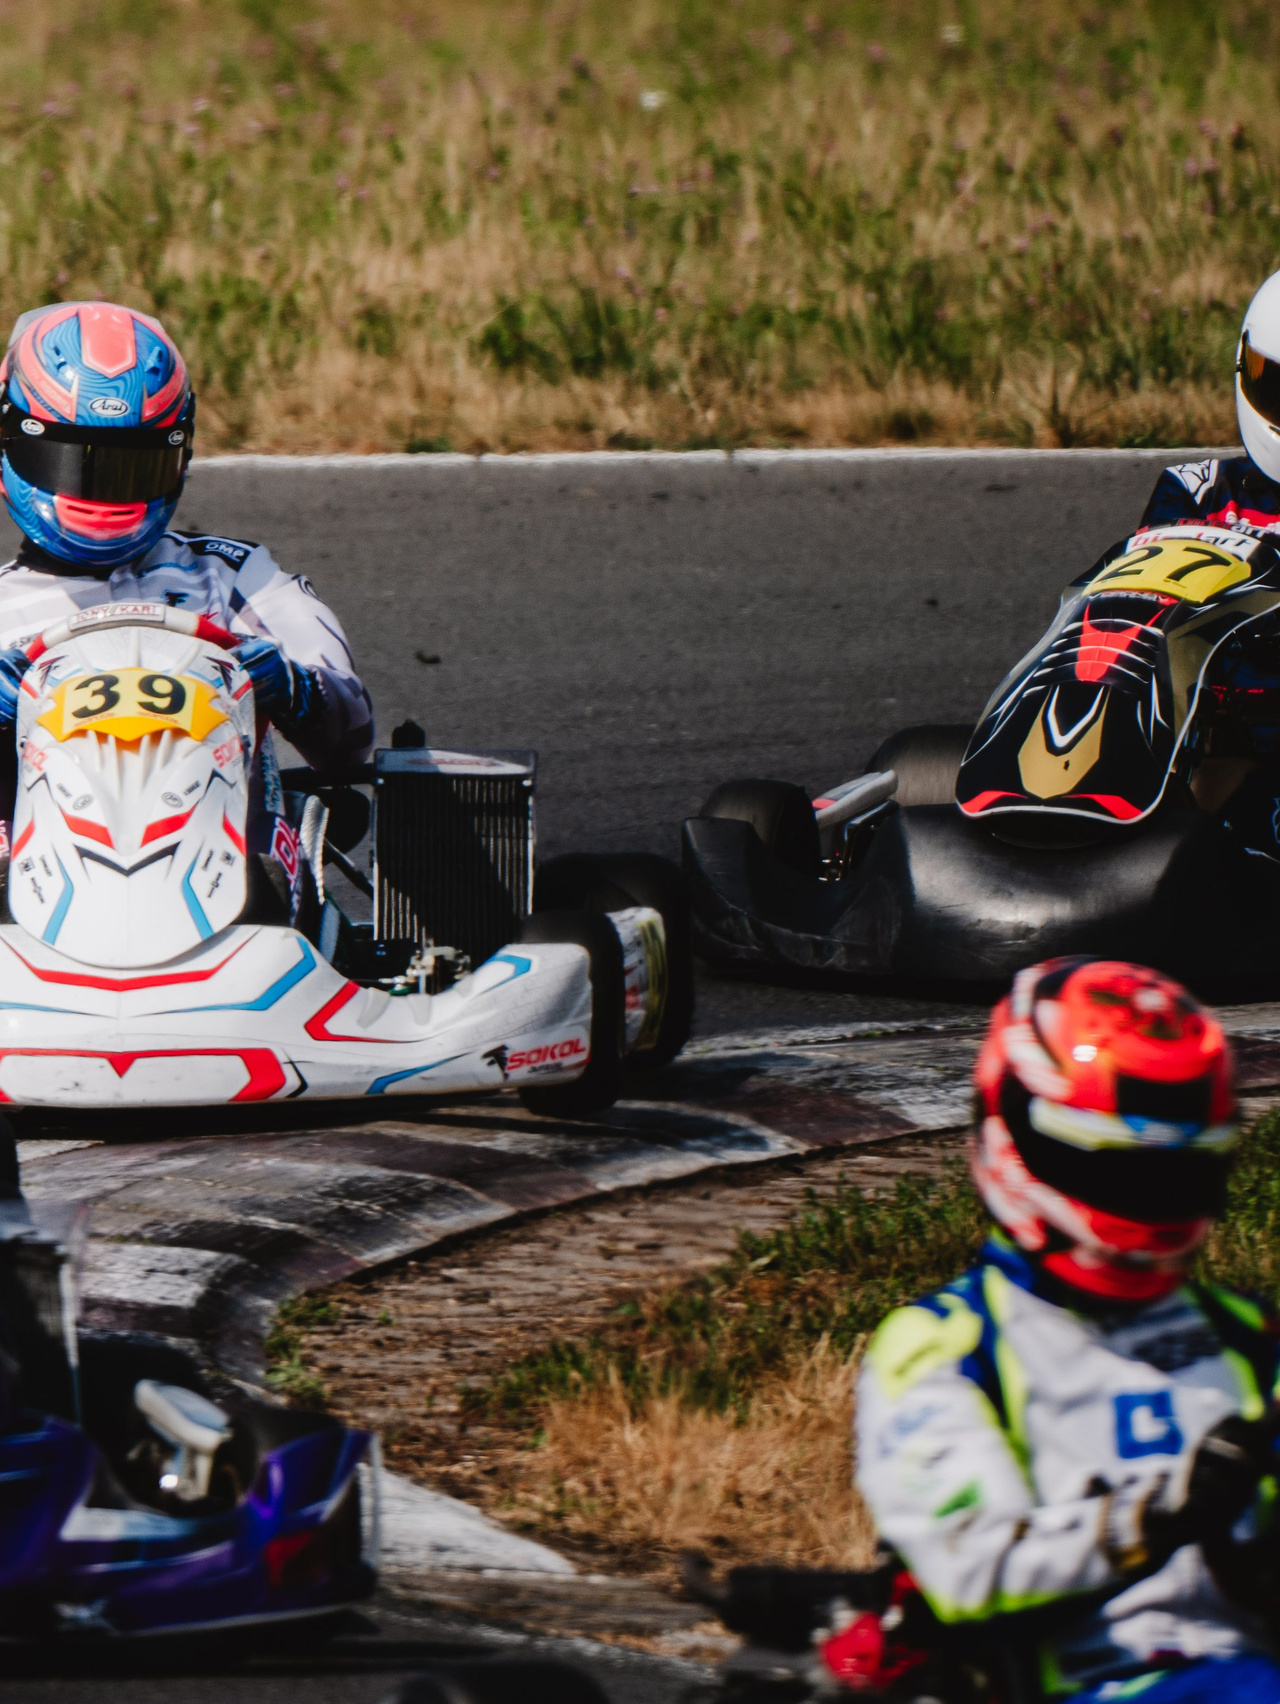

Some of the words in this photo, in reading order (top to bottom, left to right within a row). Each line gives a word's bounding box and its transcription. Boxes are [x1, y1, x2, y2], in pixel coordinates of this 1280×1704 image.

[98, 399, 124, 412] Arai
[205, 541, 245, 560] OMP
[1094, 545, 1233, 584] 27
[71, 673, 187, 719] 39
[506, 1037, 587, 1071] SOKOL
